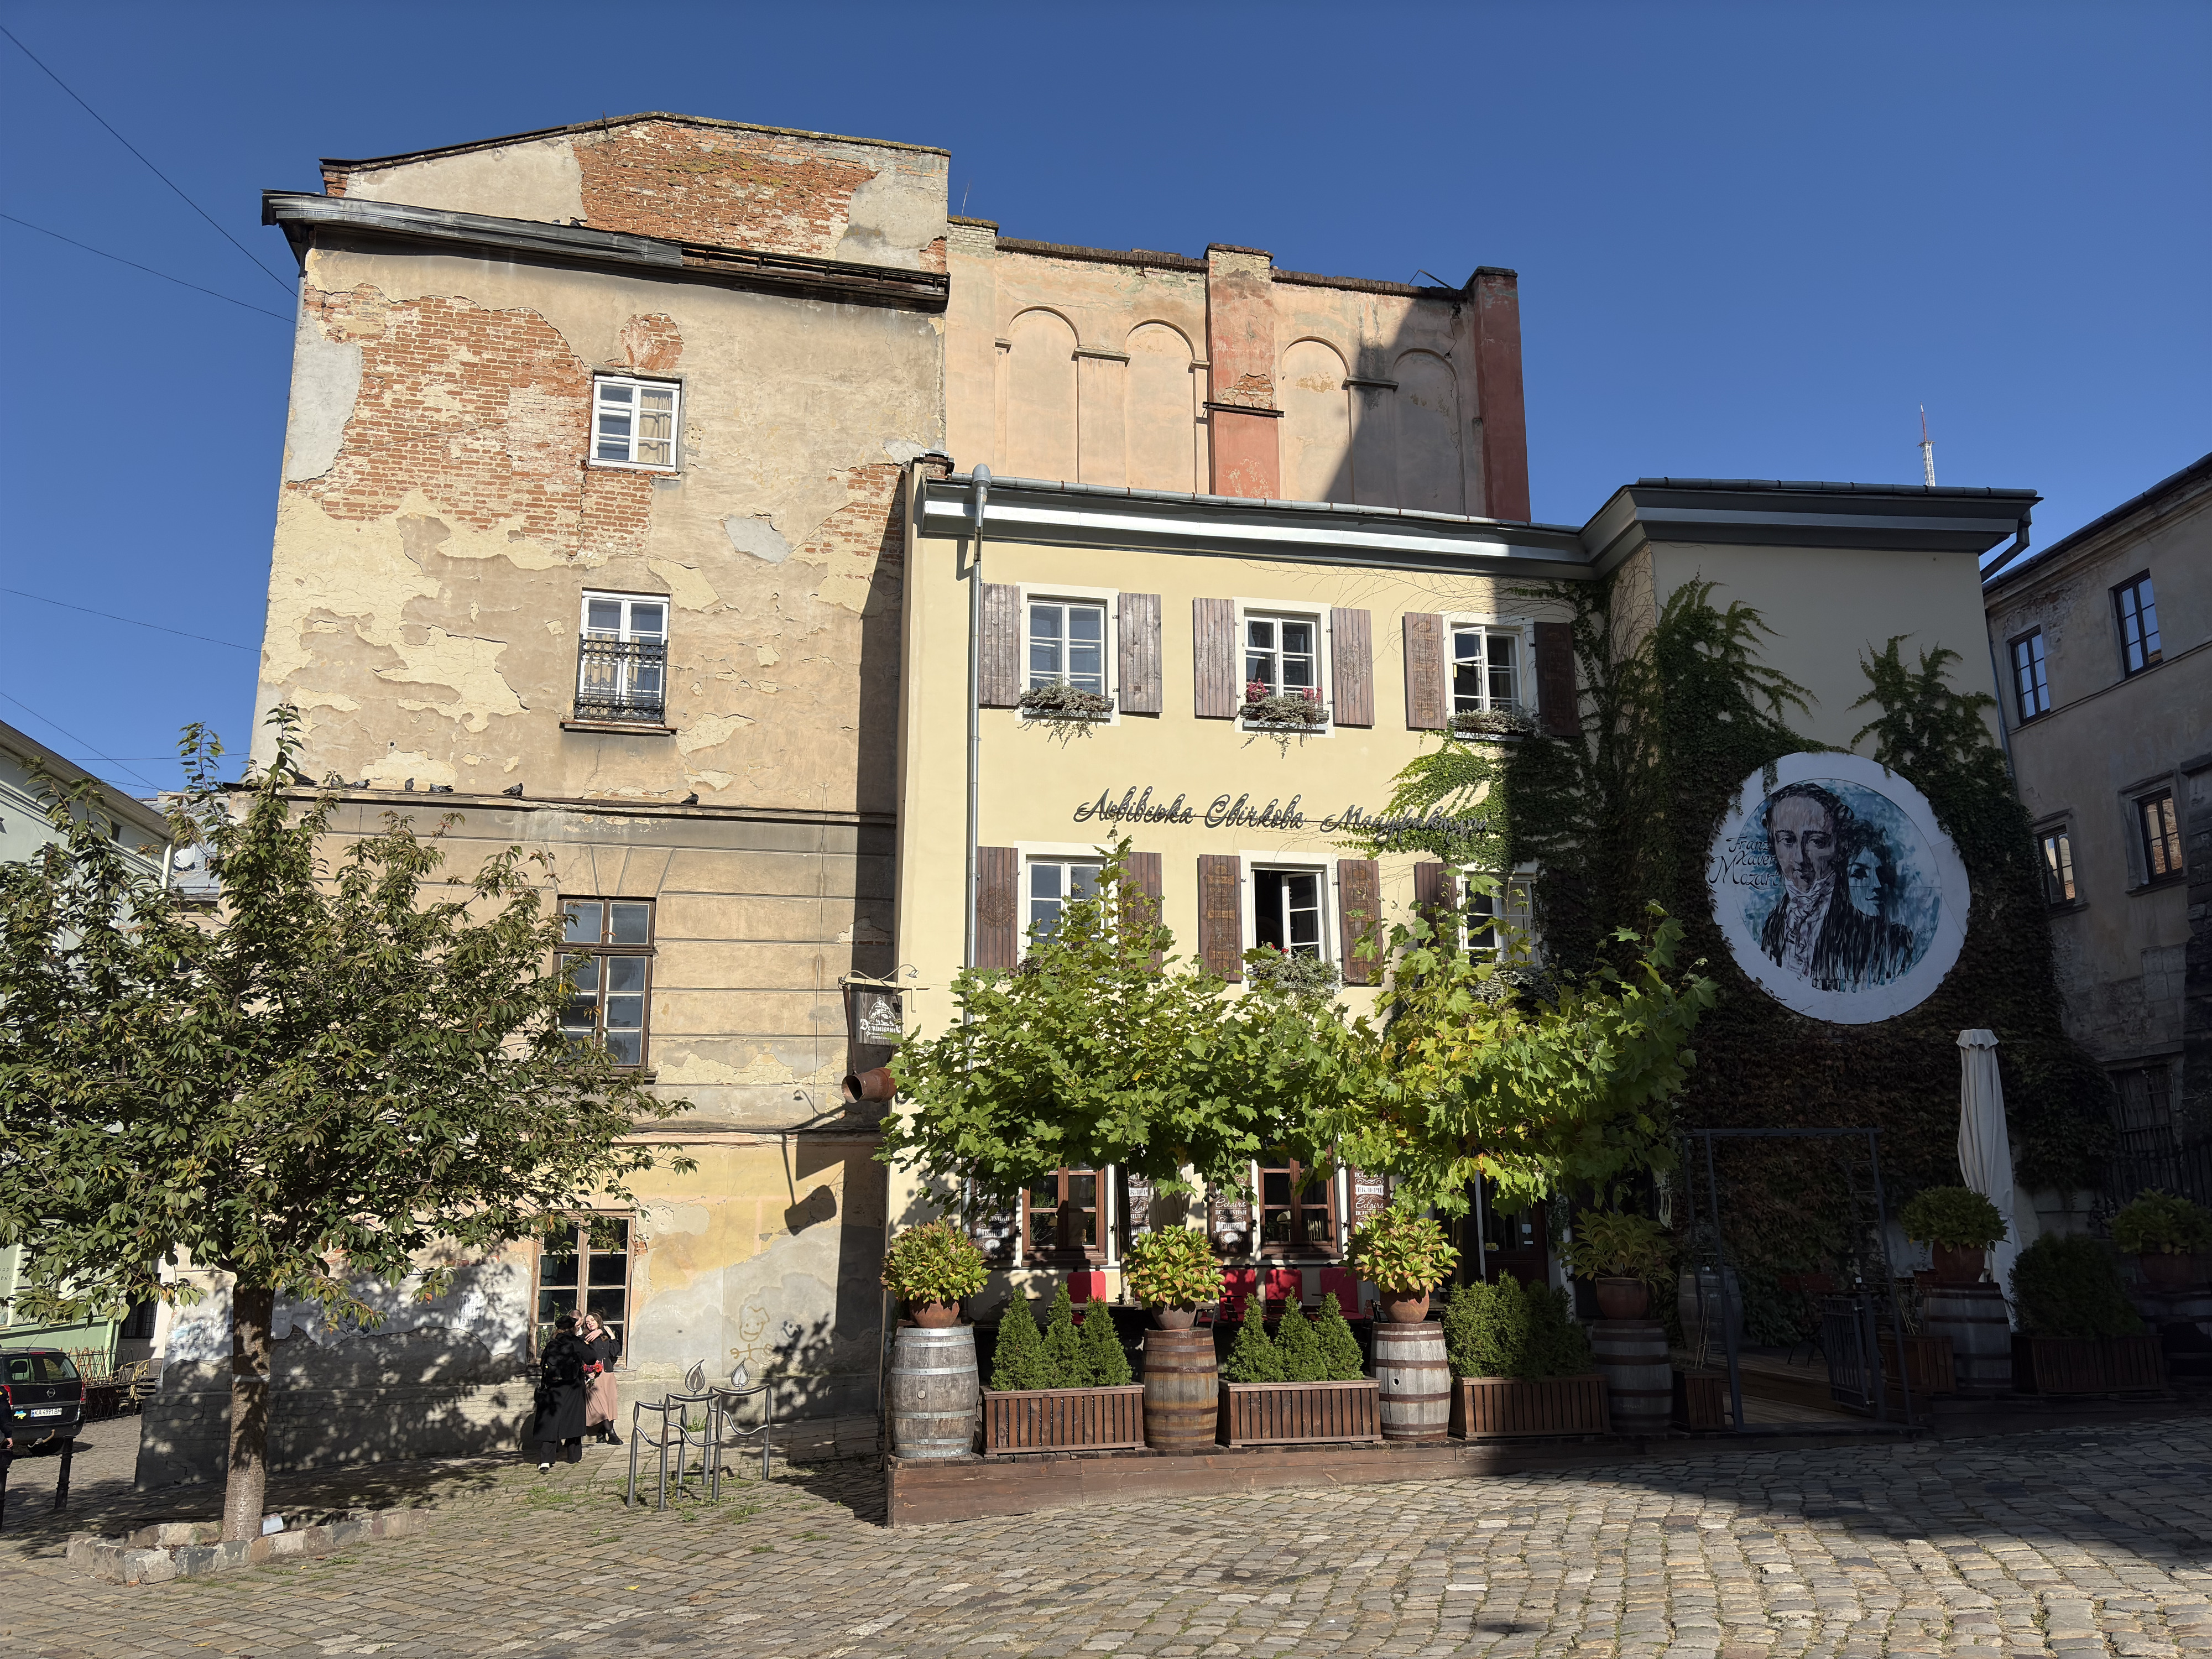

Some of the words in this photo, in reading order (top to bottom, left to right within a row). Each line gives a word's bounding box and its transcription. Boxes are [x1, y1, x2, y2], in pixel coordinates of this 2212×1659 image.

[1725, 836, 1770, 853] Franz
[1735, 851, 1776, 866] Xaver
[1708, 855, 1781, 890] Mozart
[1130, 1201, 1149, 1212] Eclair
[1355, 1199, 1384, 1209] Eclairs
